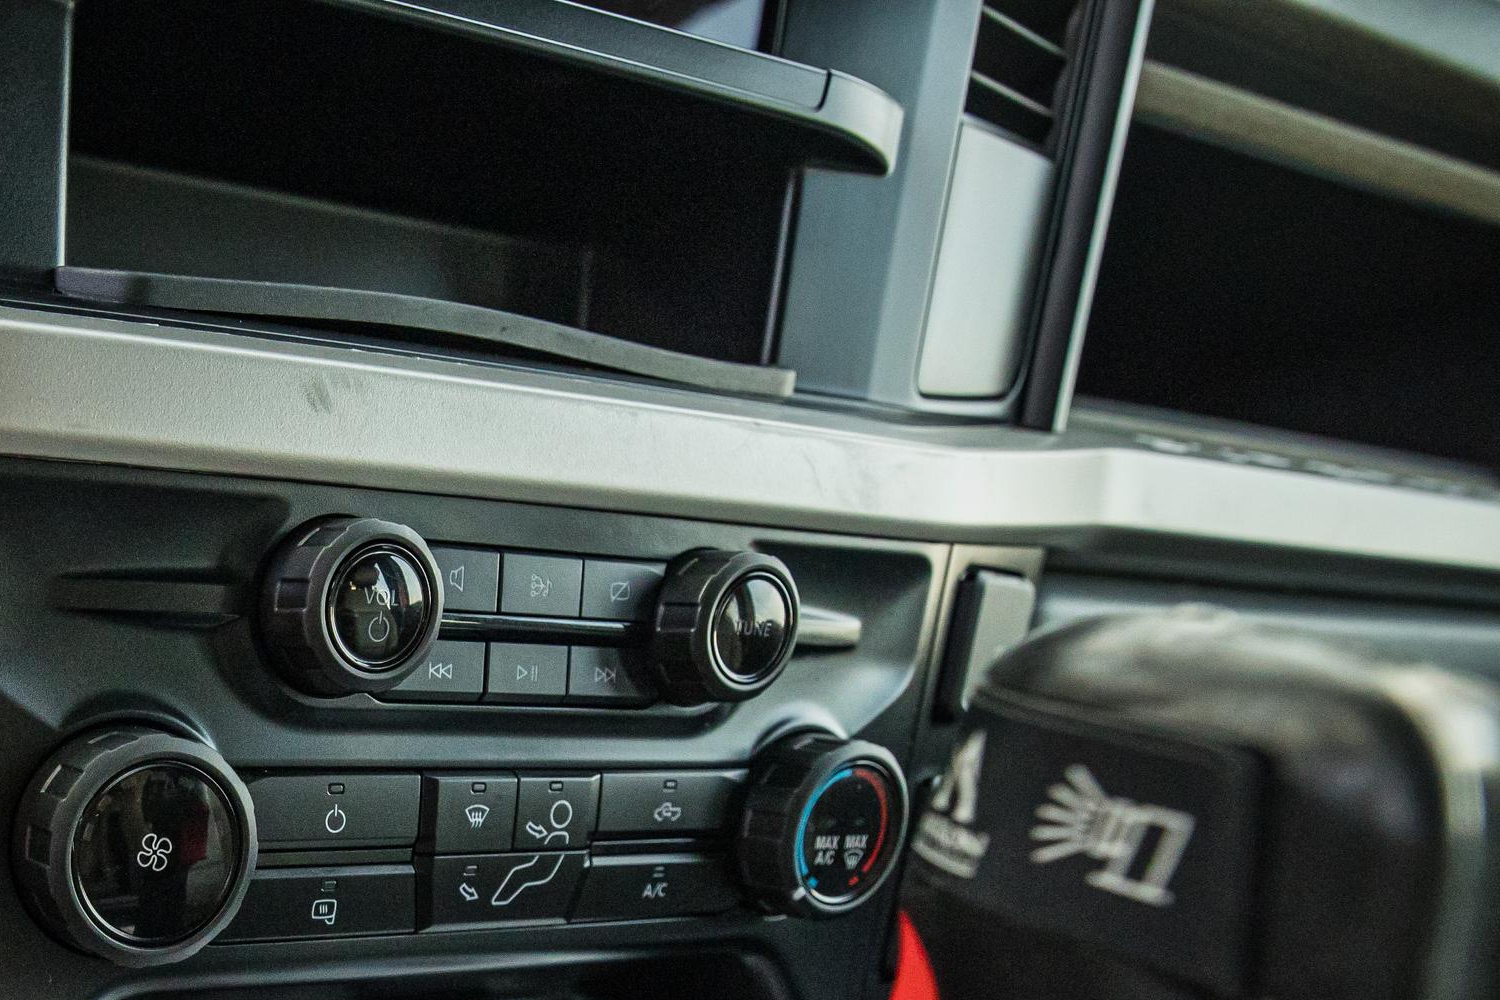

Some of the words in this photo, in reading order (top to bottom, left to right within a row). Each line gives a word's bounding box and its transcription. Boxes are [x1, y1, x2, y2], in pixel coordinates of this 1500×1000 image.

[364, 586, 399, 607] VOL
[736, 620, 773, 638] TUNE
[814, 835, 840, 850] MAX
[843, 834, 869, 849] MAX
[642, 882, 668, 899] A/C
